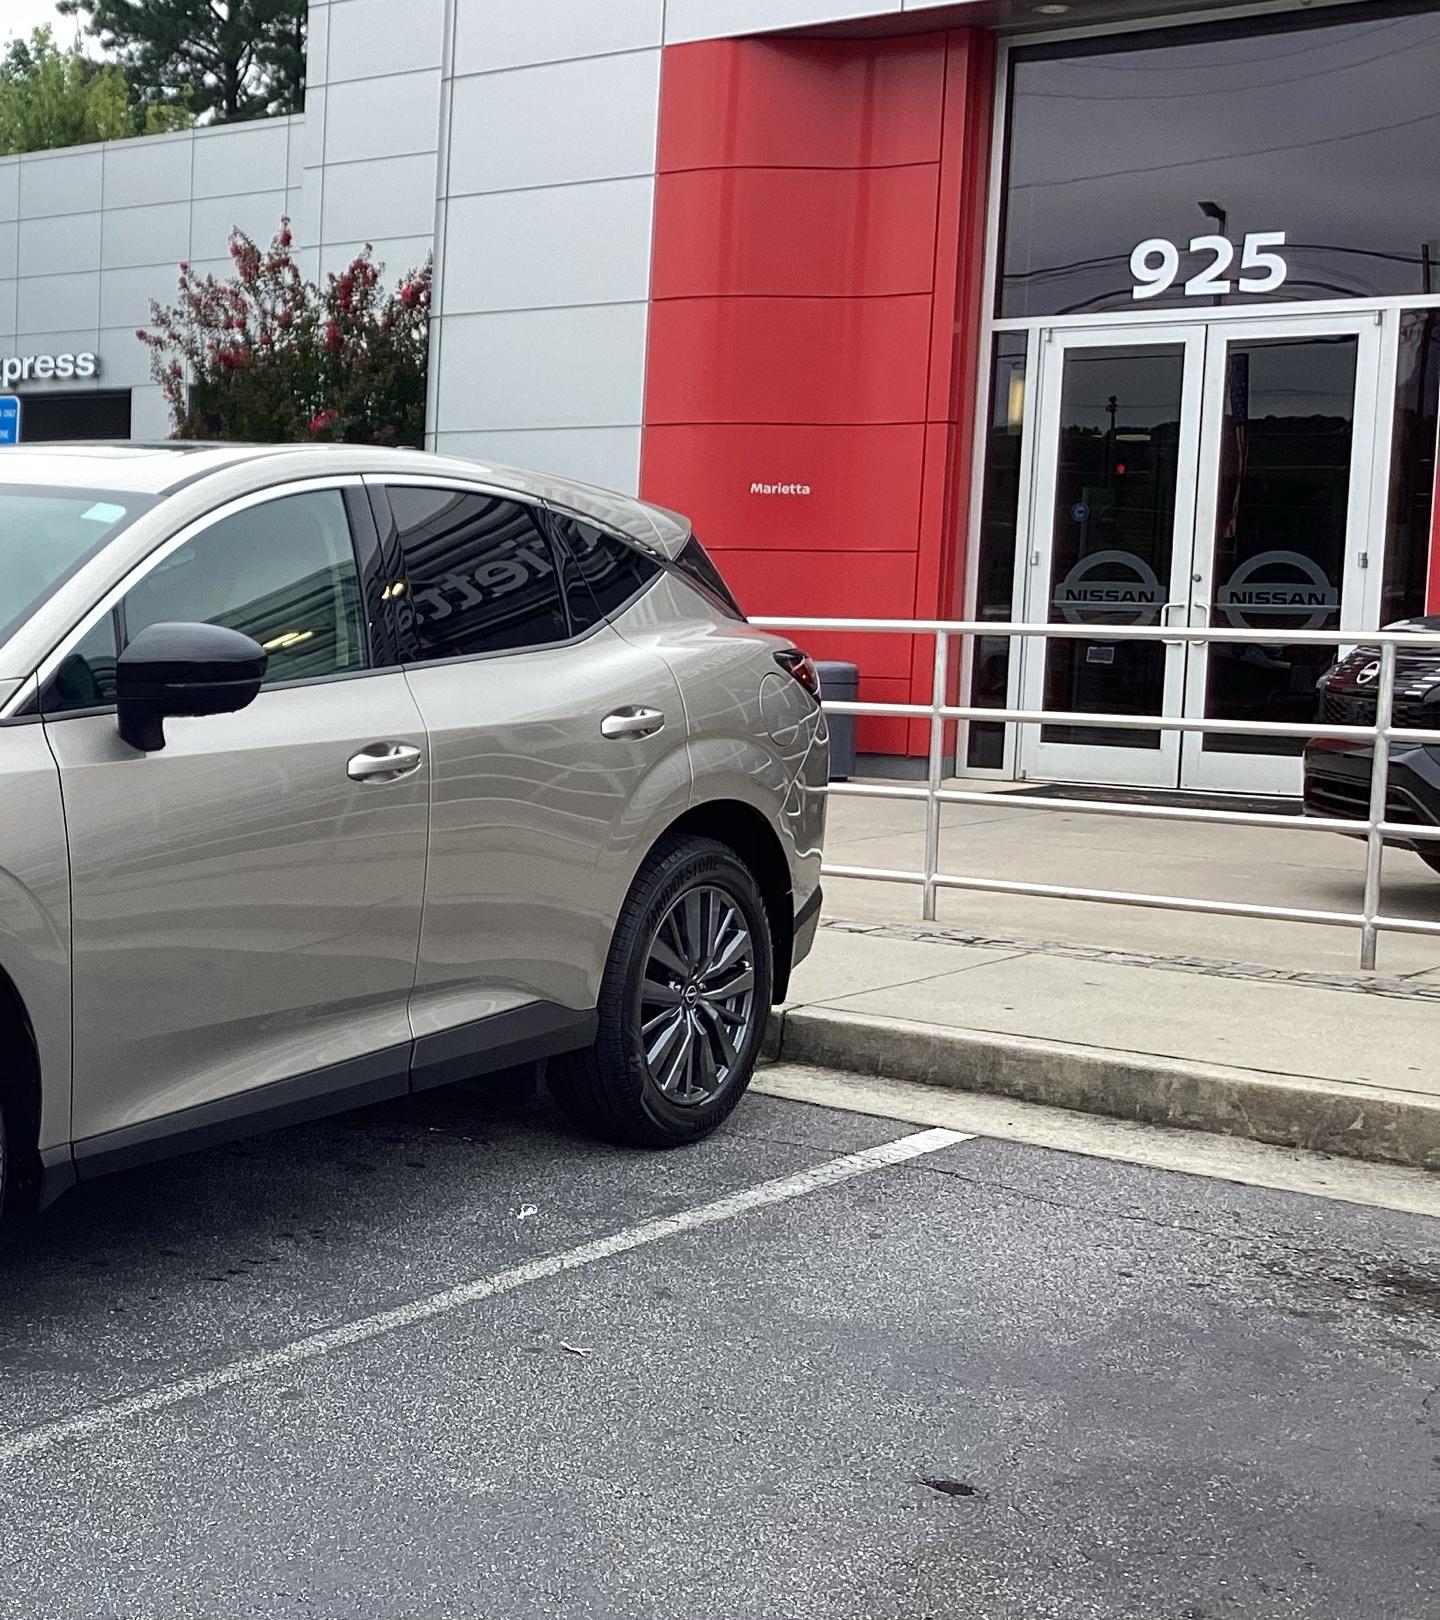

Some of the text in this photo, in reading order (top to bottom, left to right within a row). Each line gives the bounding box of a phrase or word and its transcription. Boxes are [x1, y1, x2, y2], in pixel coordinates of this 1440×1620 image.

[1130, 231, 1287, 300] 925
[750, 482, 811, 495] Marietta
[1065, 588, 1155, 603] NISSAN
[1229, 590, 1326, 606] NISSAN
